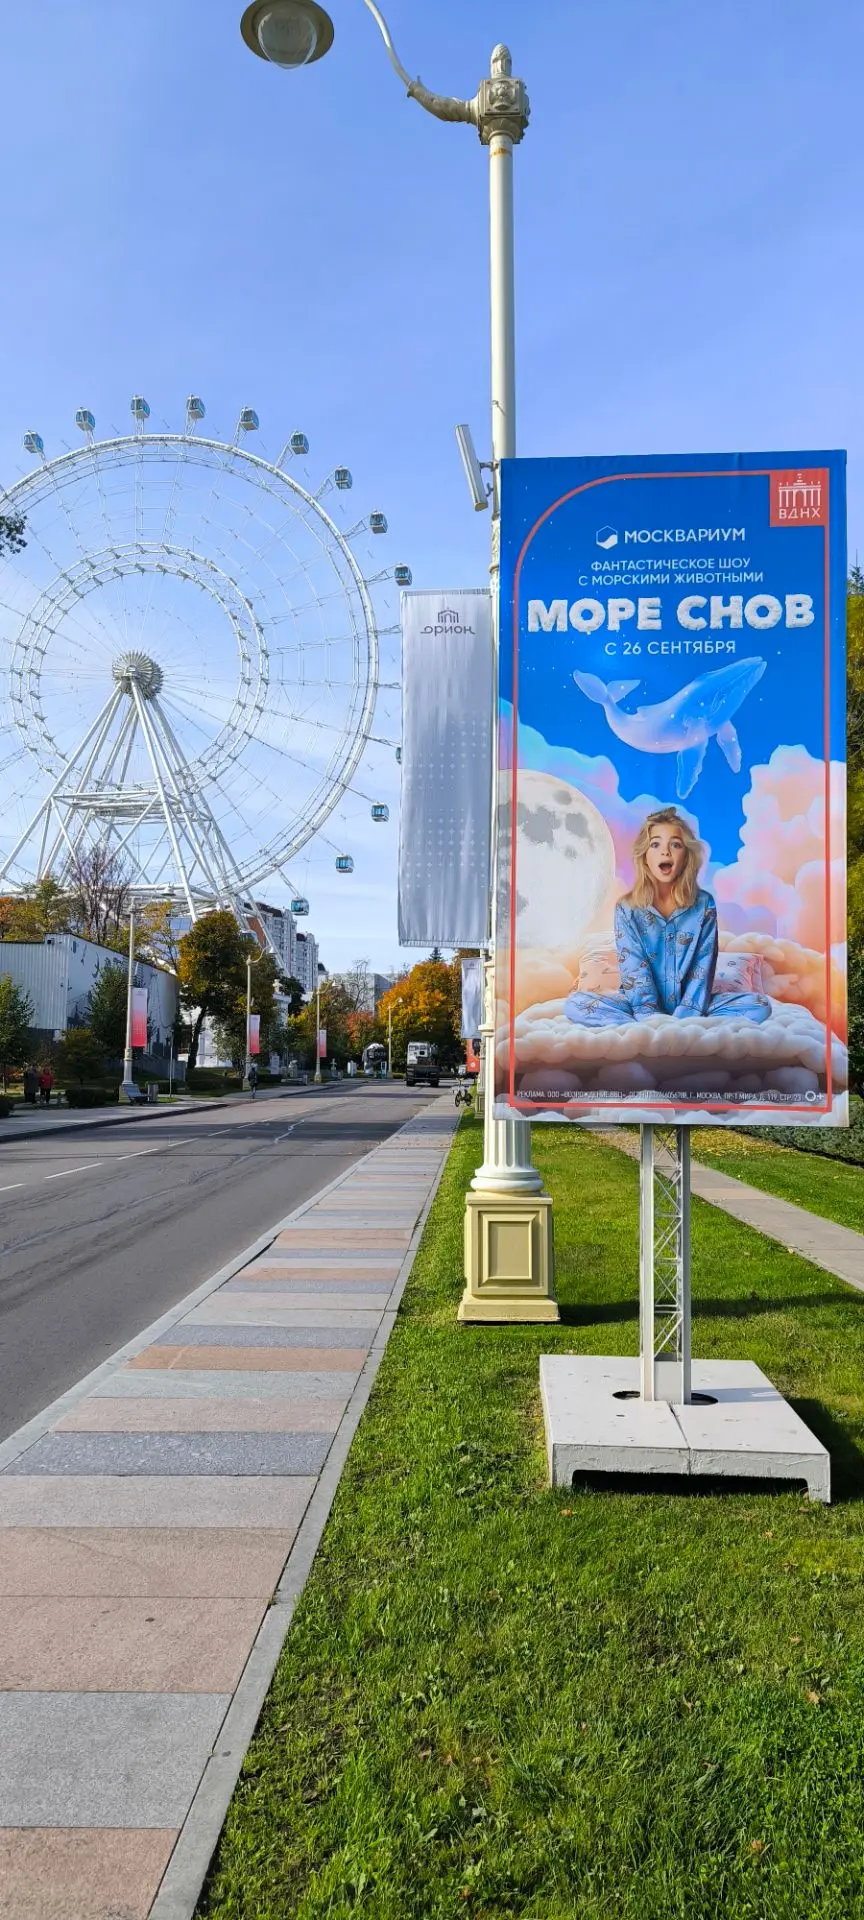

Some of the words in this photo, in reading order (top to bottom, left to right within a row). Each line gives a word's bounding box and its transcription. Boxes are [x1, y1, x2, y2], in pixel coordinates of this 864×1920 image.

[778, 507, 821, 520] ВДНХ
[624, 527, 746, 544] МОСКВАРИУМ
[591, 558, 715, 571] ФАНТАСТИЧЕСКОЕ
[718, 557, 751, 569] ШОУ
[578, 575, 588, 587] С
[592, 574, 670, 586] МОРСКИМИ
[674, 571, 764, 584] ЖИВОТНЫМИ
[527, 597, 663, 634] МОРЕ
[676, 594, 815, 630] СНОВ
[604, 642, 617, 655] С
[622, 642, 642, 655] 26
[647, 640, 736, 654] СЕНТЯБРЯ
